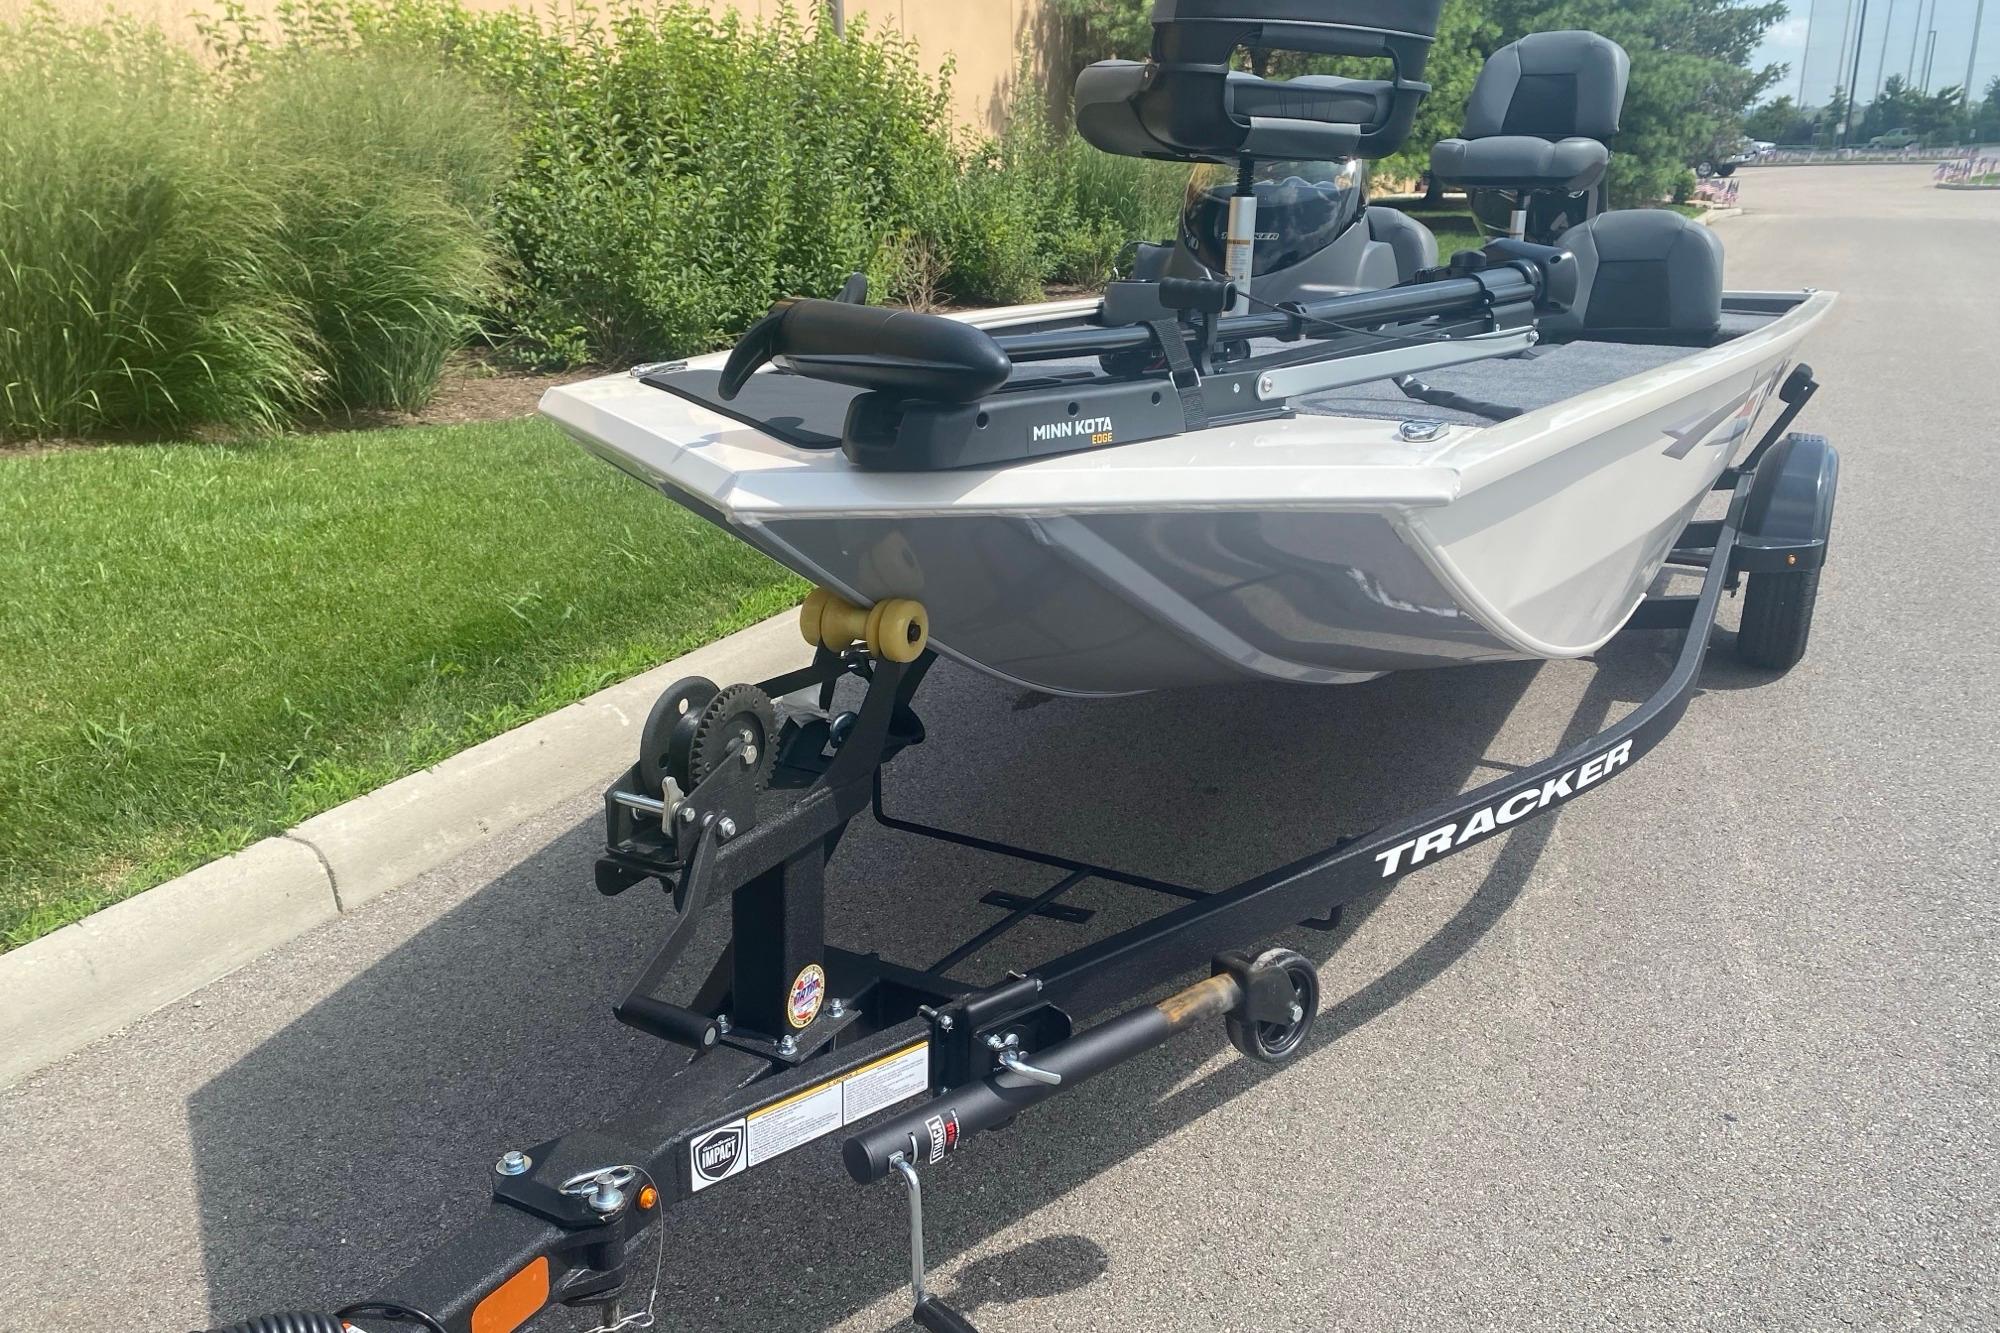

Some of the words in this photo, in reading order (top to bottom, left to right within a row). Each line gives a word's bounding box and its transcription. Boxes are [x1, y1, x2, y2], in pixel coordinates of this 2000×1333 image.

[1033, 421, 1072, 441] MINN
[1075, 416, 1113, 435] KOTA
[1091, 432, 1113, 444] EDGE
[1375, 739, 1633, 878] TRACKER
[702, 1139, 736, 1169] IMPACT
[930, 1120, 944, 1158] ITHACA
